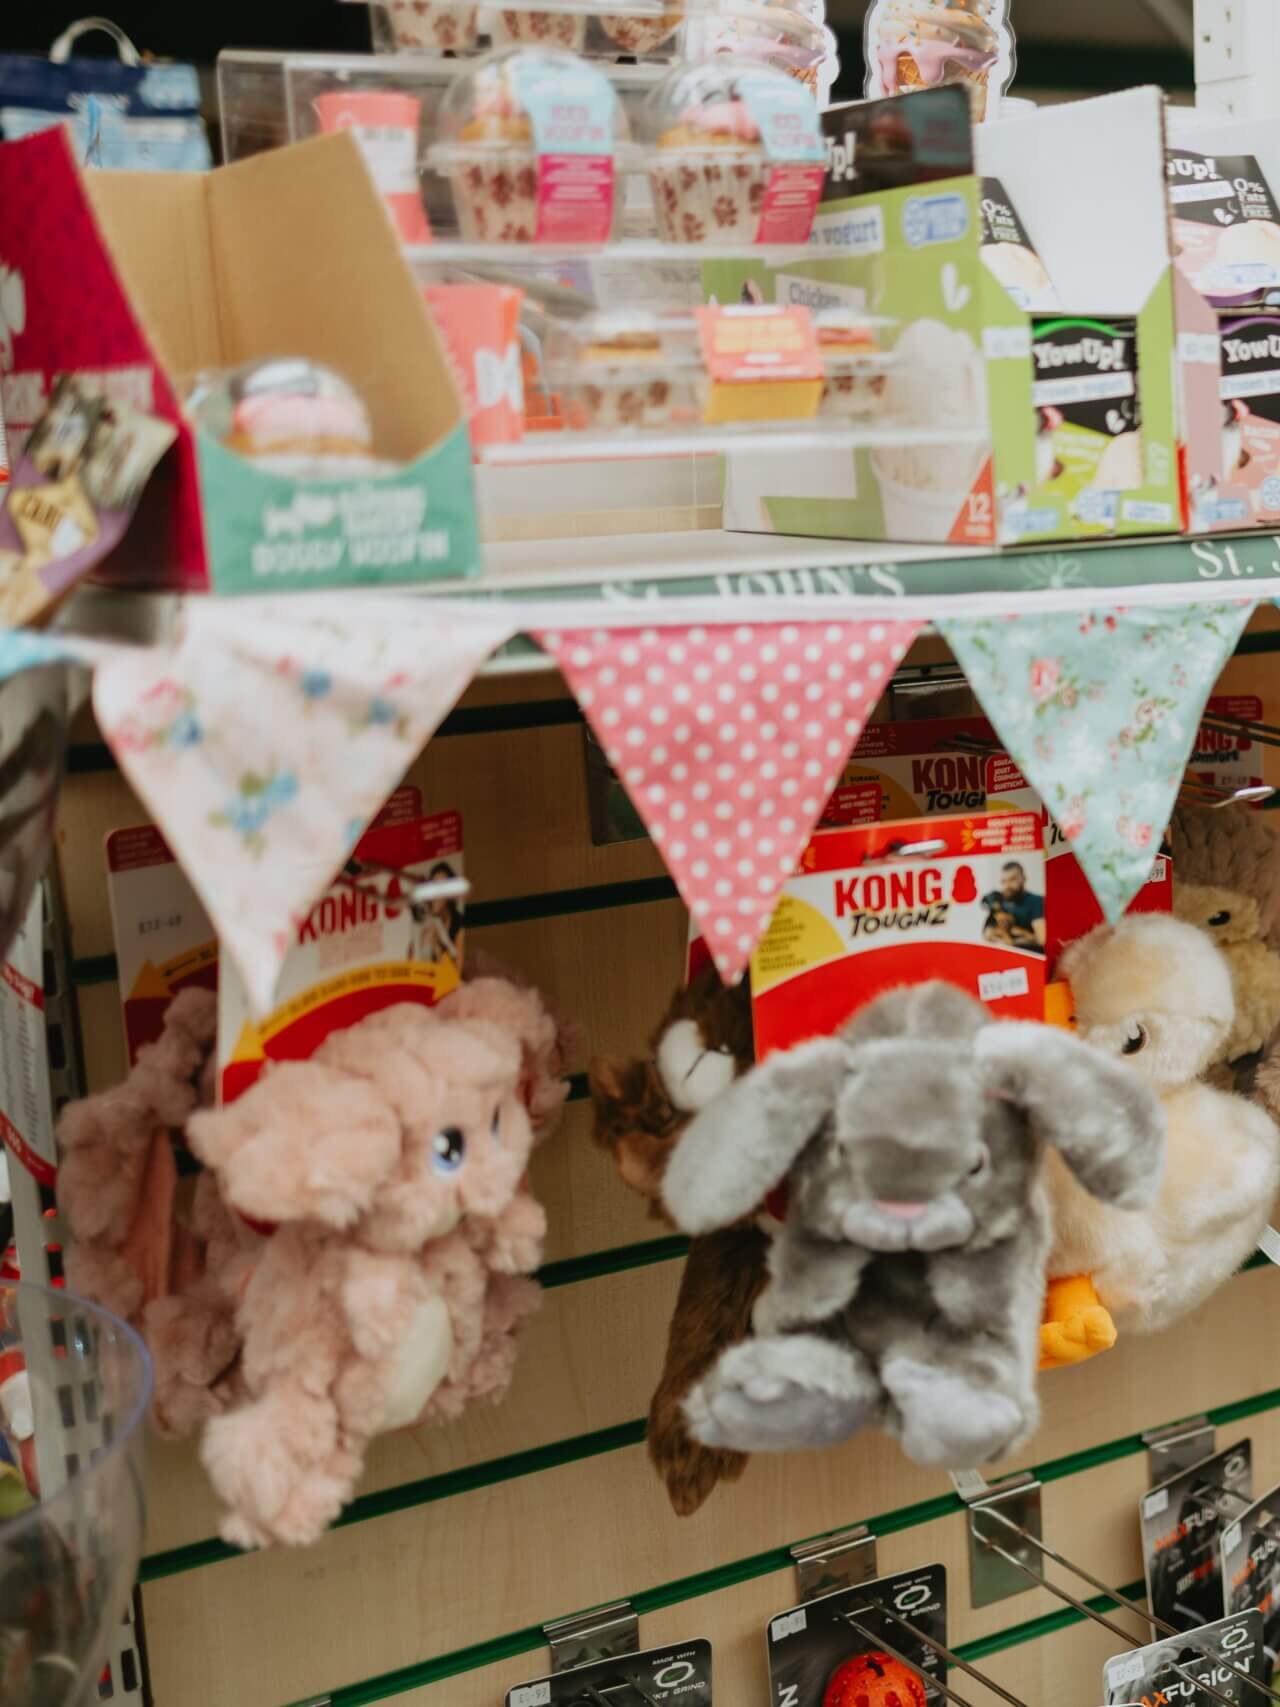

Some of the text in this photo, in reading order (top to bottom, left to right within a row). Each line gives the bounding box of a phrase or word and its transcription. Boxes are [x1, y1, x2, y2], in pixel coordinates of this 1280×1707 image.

[1233, 178, 1265, 193] 0%
[1031, 337, 1126, 370] YowUp!
[968, 493, 992, 522] 12
[1190, 540, 1255, 579] St.
[912, 756, 987, 795] KON
[834, 868, 943, 918] KONG
[298, 885, 379, 947] KONG
[850, 903, 950, 937] TOUGHZ
